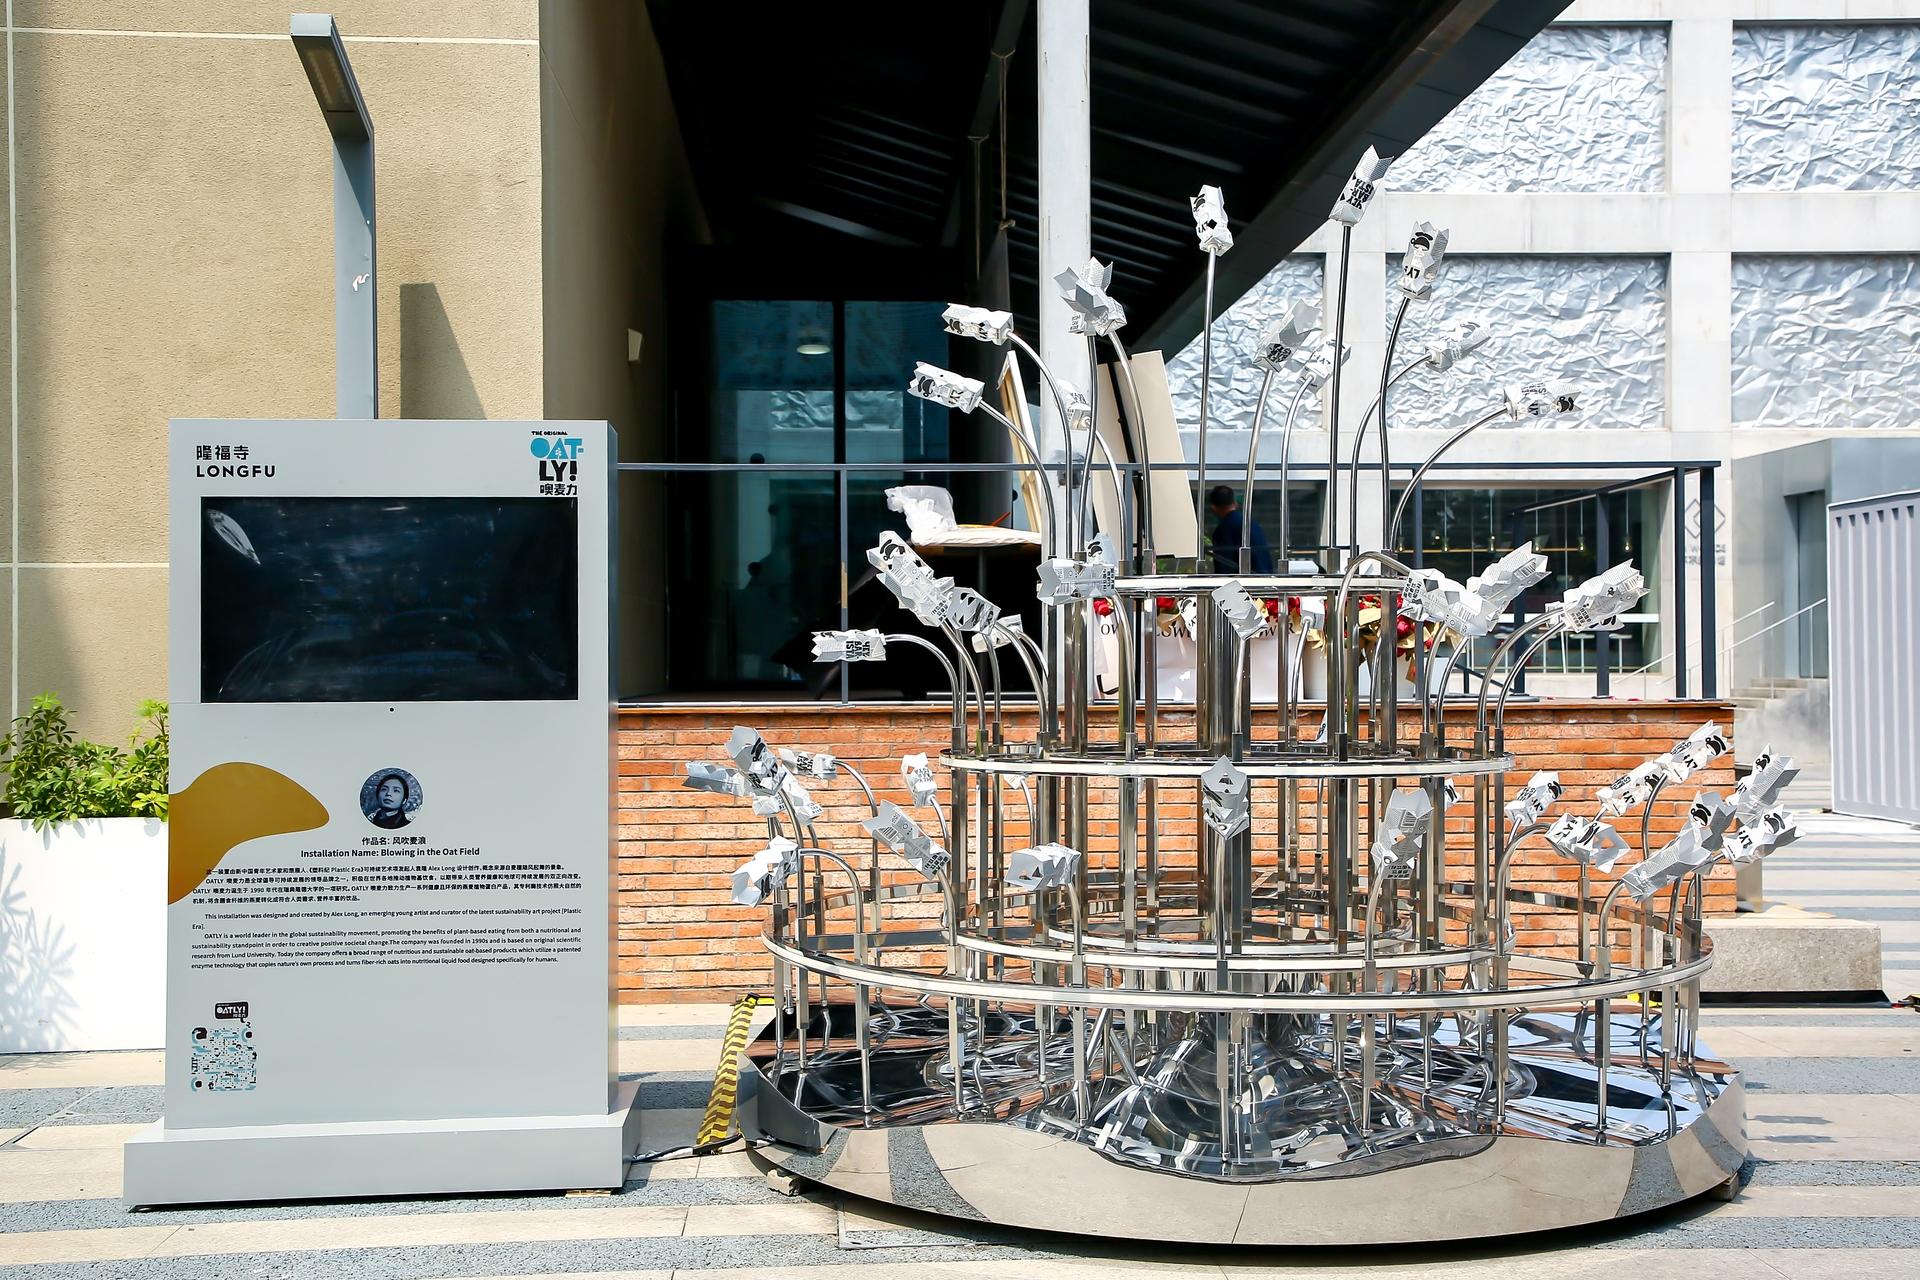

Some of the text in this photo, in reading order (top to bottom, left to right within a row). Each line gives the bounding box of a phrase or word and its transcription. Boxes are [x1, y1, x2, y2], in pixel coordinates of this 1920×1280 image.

[196, 445, 249, 460] 隆福寺
[530, 437, 584, 459] OAT-
[196, 465, 275, 478] LONGFU
[539, 460, 578, 482] LY!
[540, 483, 578, 495] 噢麦力
[1739, 830, 1753, 848] LY!
[300, 848, 349, 857] Installation
[380, 848, 415, 858] Blowing
[426, 847, 440, 855] the
[459, 847, 479, 855] Field
[217, 1006, 246, 1014] OATLY!
